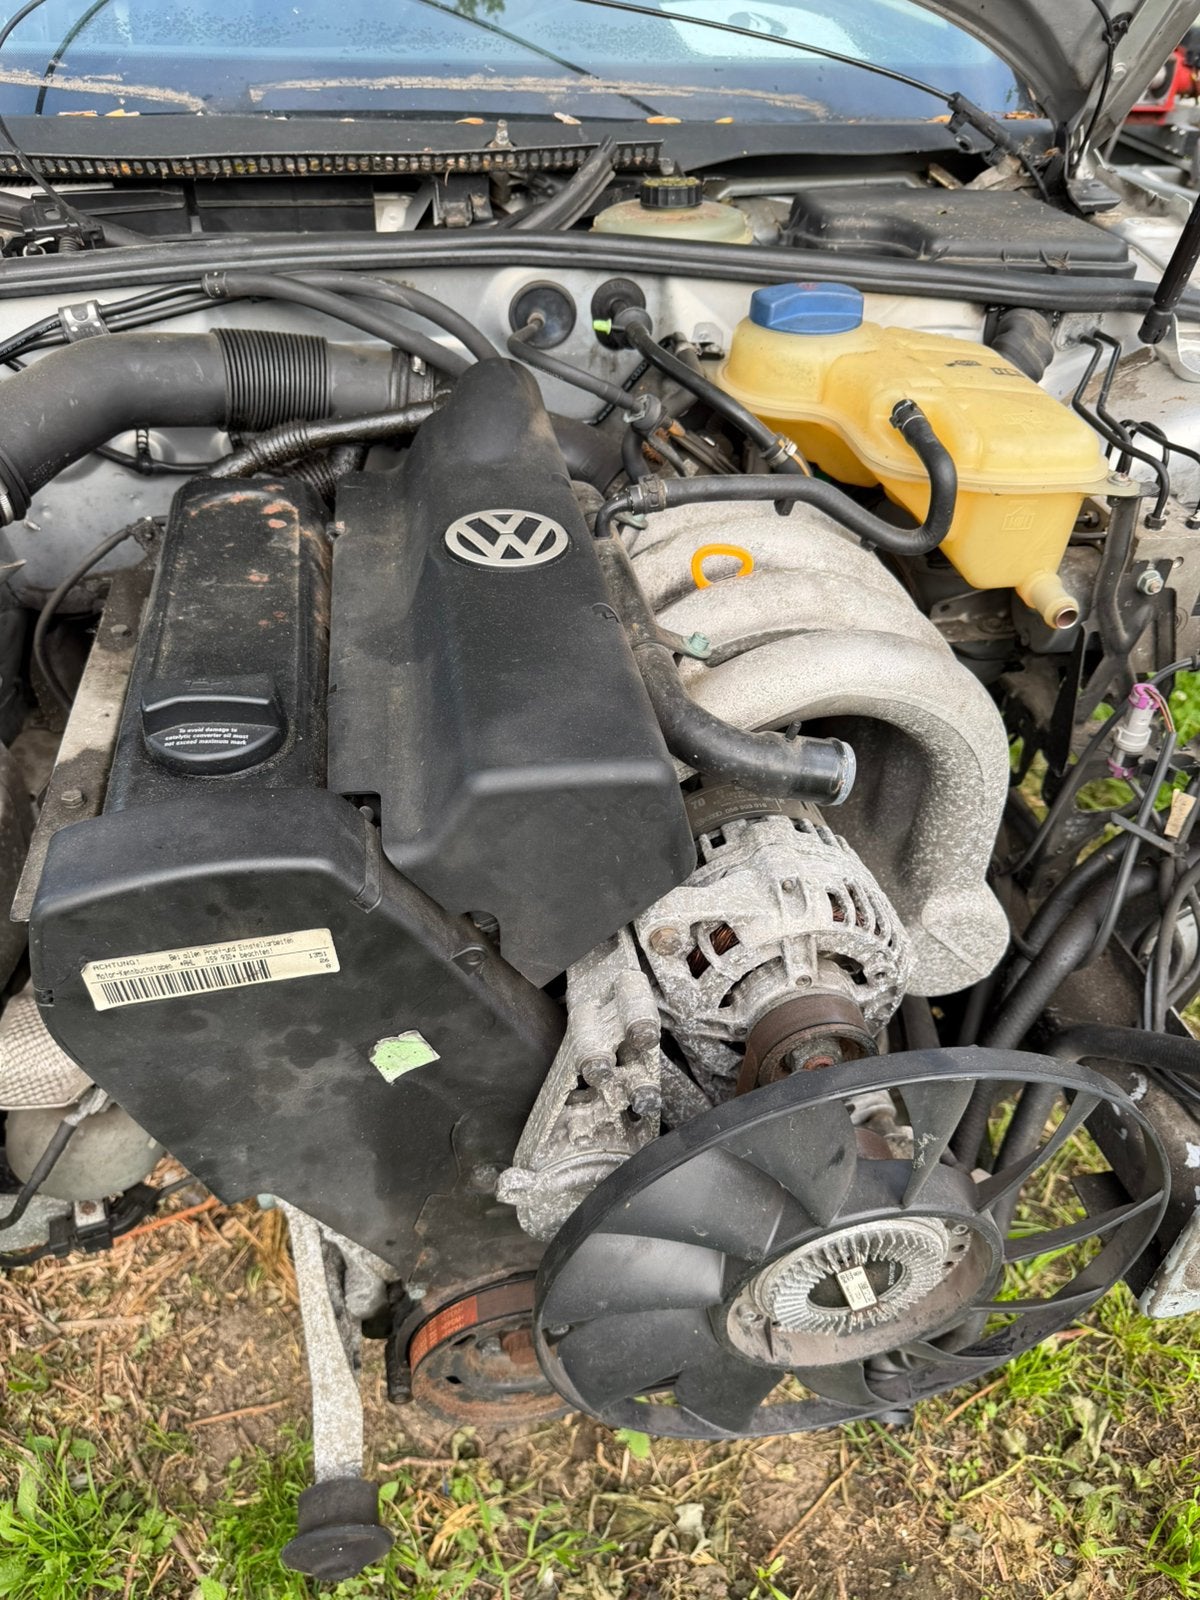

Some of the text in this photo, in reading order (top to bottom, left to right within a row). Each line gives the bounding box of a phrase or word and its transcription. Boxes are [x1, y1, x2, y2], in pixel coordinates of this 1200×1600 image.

[445, 508, 569, 568] VW
[168, 953, 181, 961] Bei
[182, 951, 200, 959] allen
